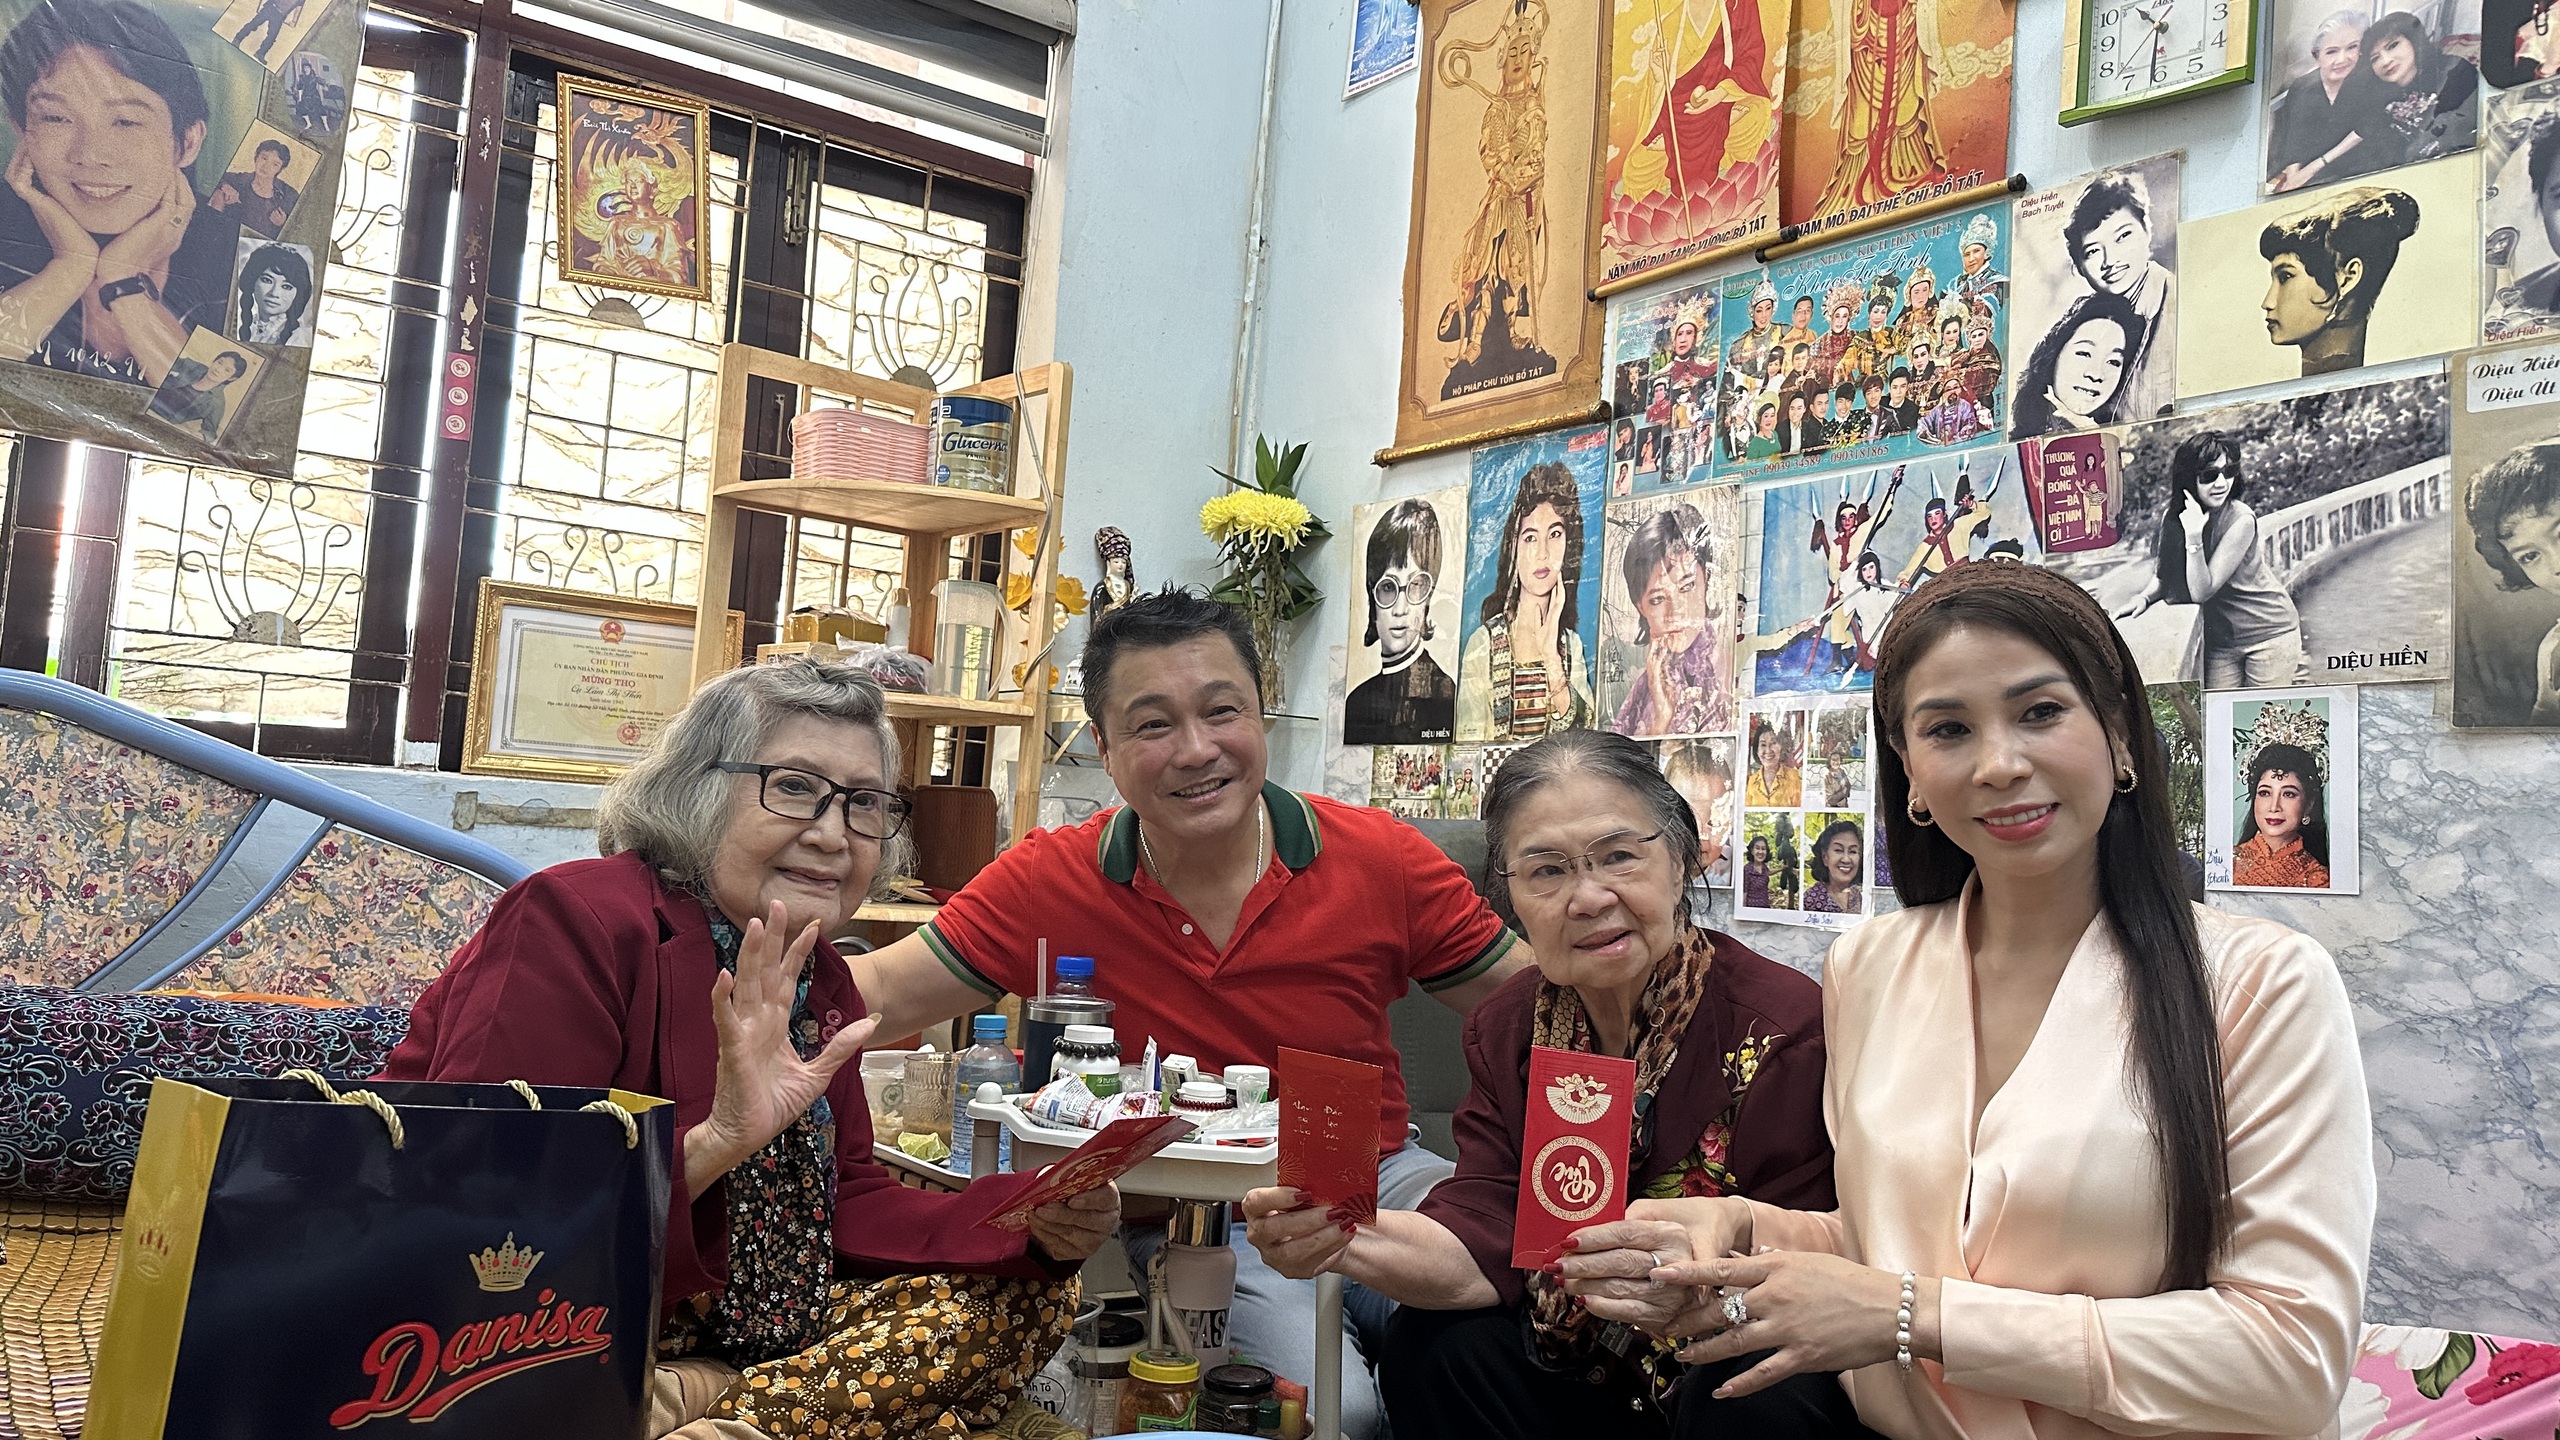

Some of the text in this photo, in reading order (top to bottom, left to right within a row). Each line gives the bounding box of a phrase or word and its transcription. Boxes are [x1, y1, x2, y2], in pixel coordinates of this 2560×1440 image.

[2101, 9, 2119, 28] 10
[2213, 3, 2228, 21] 3
[2101, 36, 2115, 52] 9
[2211, 29, 2227, 49] 4
[2100, 61, 2114, 78] 8
[2153, 65, 2167, 83] 6
[2187, 56, 2204, 74] 5
[2122, 74, 2136, 92] 7
[1796, 219, 1822, 238] NAM
[1825, 209, 1845, 231] MÔ
[1874, 191, 1904, 215] THẾ
[1906, 184, 1928, 206] CHÍ
[1932, 174, 1953, 199] BỒ
[1957, 170, 1984, 191] TÁT
[1748, 212, 1768, 234] TÁT
[2472, 363, 2516, 379] Diệu
[1463, 379, 1482, 394] PHÁP
[2481, 387, 2527, 403] Diệu
[942, 431, 1008, 453] Glucerna
[2327, 644, 2429, 672] DIỆU HIỀN
[329, 1288, 613, 1431] Danisa
